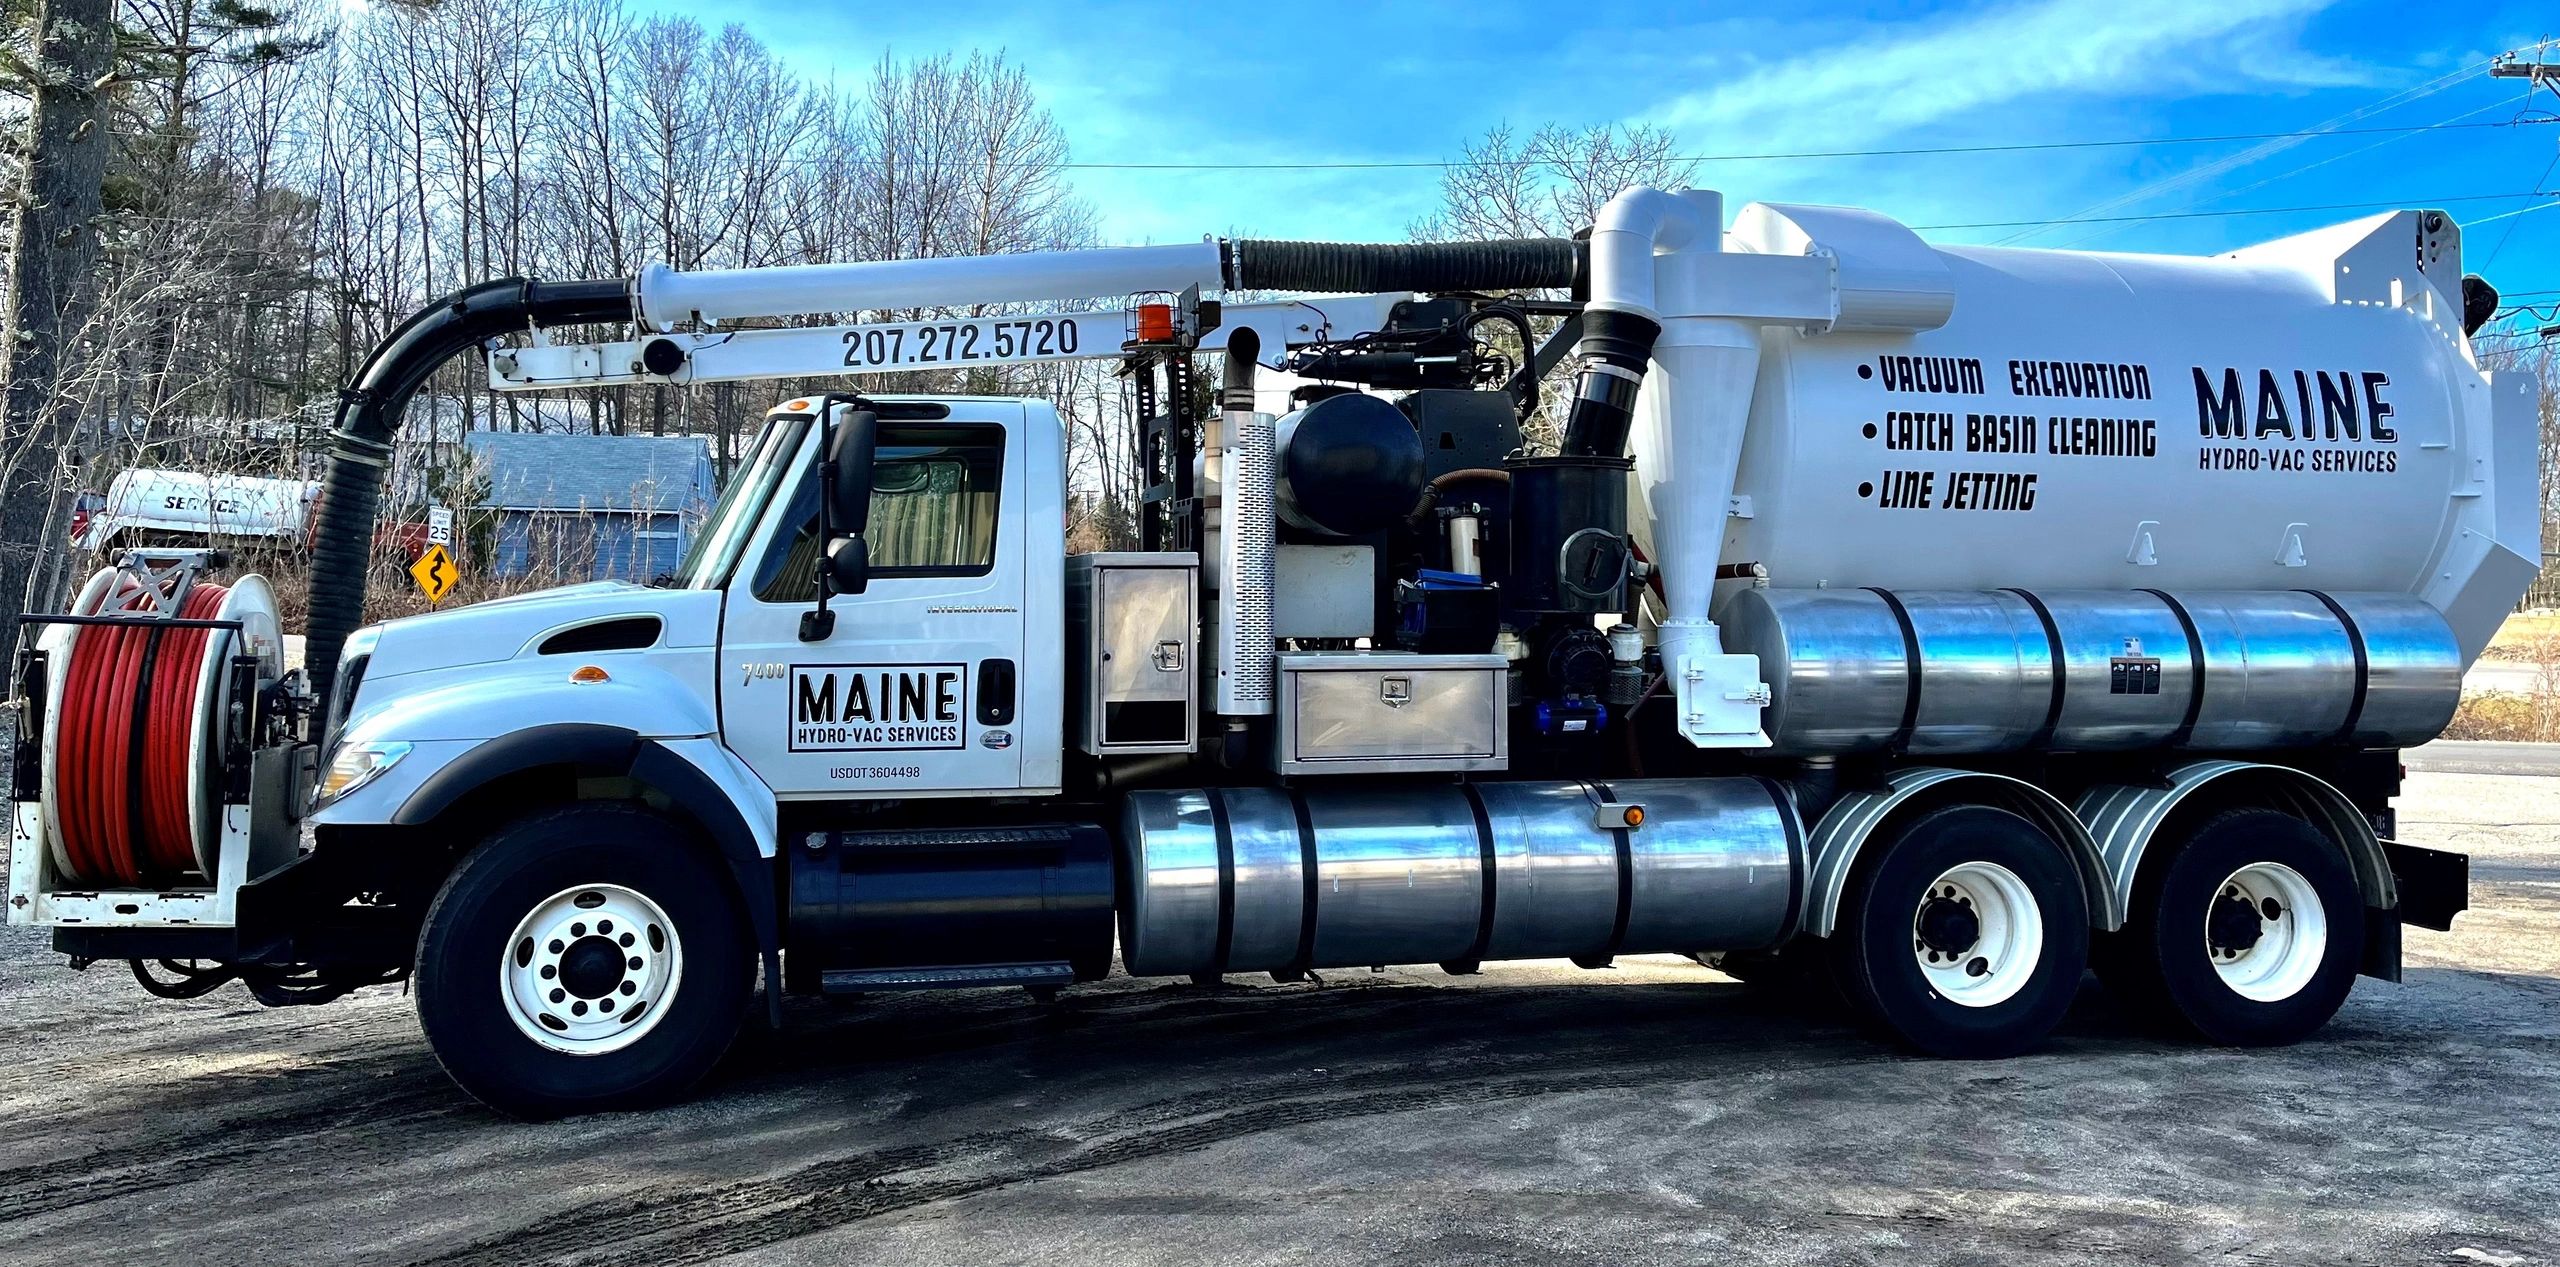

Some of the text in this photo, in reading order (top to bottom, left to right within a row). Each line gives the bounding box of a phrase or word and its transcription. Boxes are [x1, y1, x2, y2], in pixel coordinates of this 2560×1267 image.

[842, 318, 1078, 367] 207.272.5720
[1878, 355, 2152, 400] VACUUM EXCAVATION
[2191, 366, 2398, 443] MAINE
[1886, 411, 2157, 458] CATCH BASIN CLEANING
[2199, 447, 2398, 474] HYDRO-VAC SERVICES
[1879, 470, 2038, 511] LINE JETTING
[432, 511, 449, 519] SPEED
[431, 526, 449, 540] 25
[926, 604, 1018, 614] INTERNATIONAL
[741, 663, 784, 687] 7400
[798, 672, 958, 725] MAINE
[798, 726, 957, 744] HYDRO-VAC SERVICES
